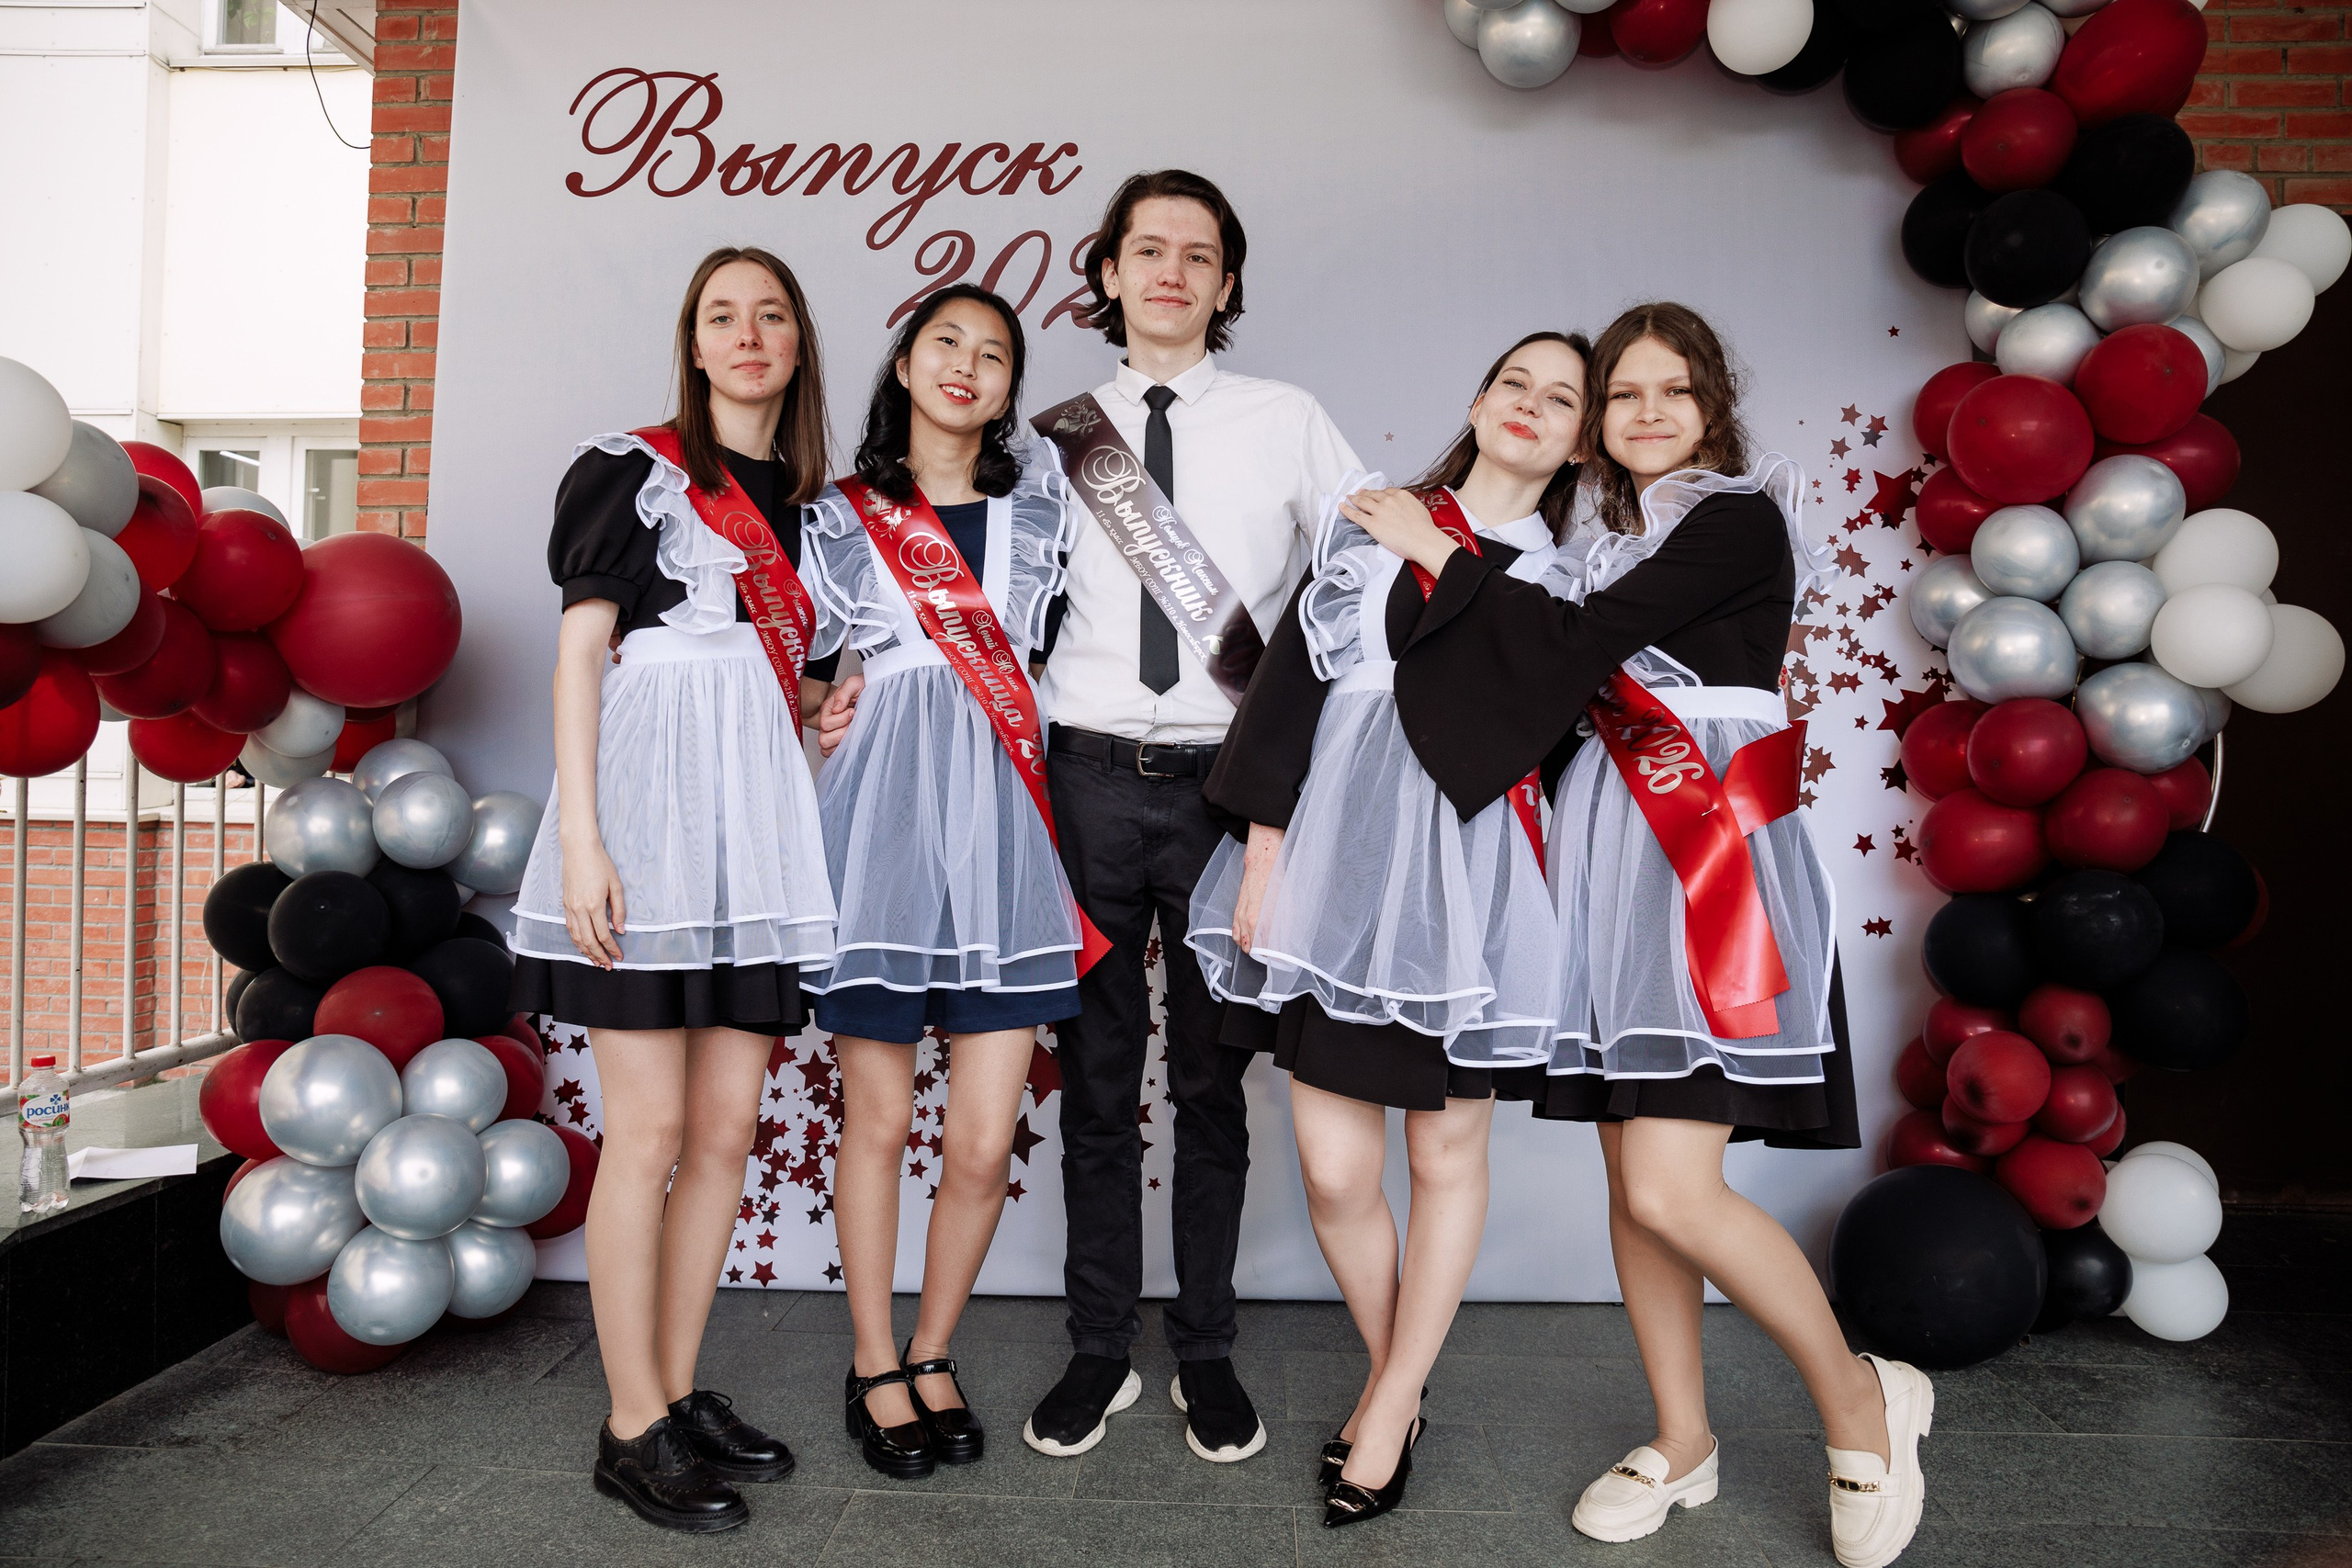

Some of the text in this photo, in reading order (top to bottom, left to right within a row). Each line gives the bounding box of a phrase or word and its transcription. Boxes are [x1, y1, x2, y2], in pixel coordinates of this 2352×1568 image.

[565, 67, 1082, 251] Выпуск
[887, 230, 1104, 330] 202
[1081, 446, 1213, 622] Выпускник
[722, 511, 806, 681] Выпускн
[744, 595, 757, 615] класс
[899, 531, 1024, 728] Выпускница
[1130, 557, 1150, 579] МБОУ
[1145, 577, 1162, 595] СОШ
[1159, 595, 1176, 616] №210
[1176, 619, 1207, 663] Новосибирск
[761, 630, 778, 655] МБОУ
[772, 656, 786, 676] СОШ
[992, 649, 1019, 692] Юлия
[957, 666, 975, 684] СОШ
[971, 684, 988, 705] №210
[989, 711, 1015, 756] Новосибирск
[1615, 705, 1705, 795] 2026
[27, 1103, 70, 1119] росинк
